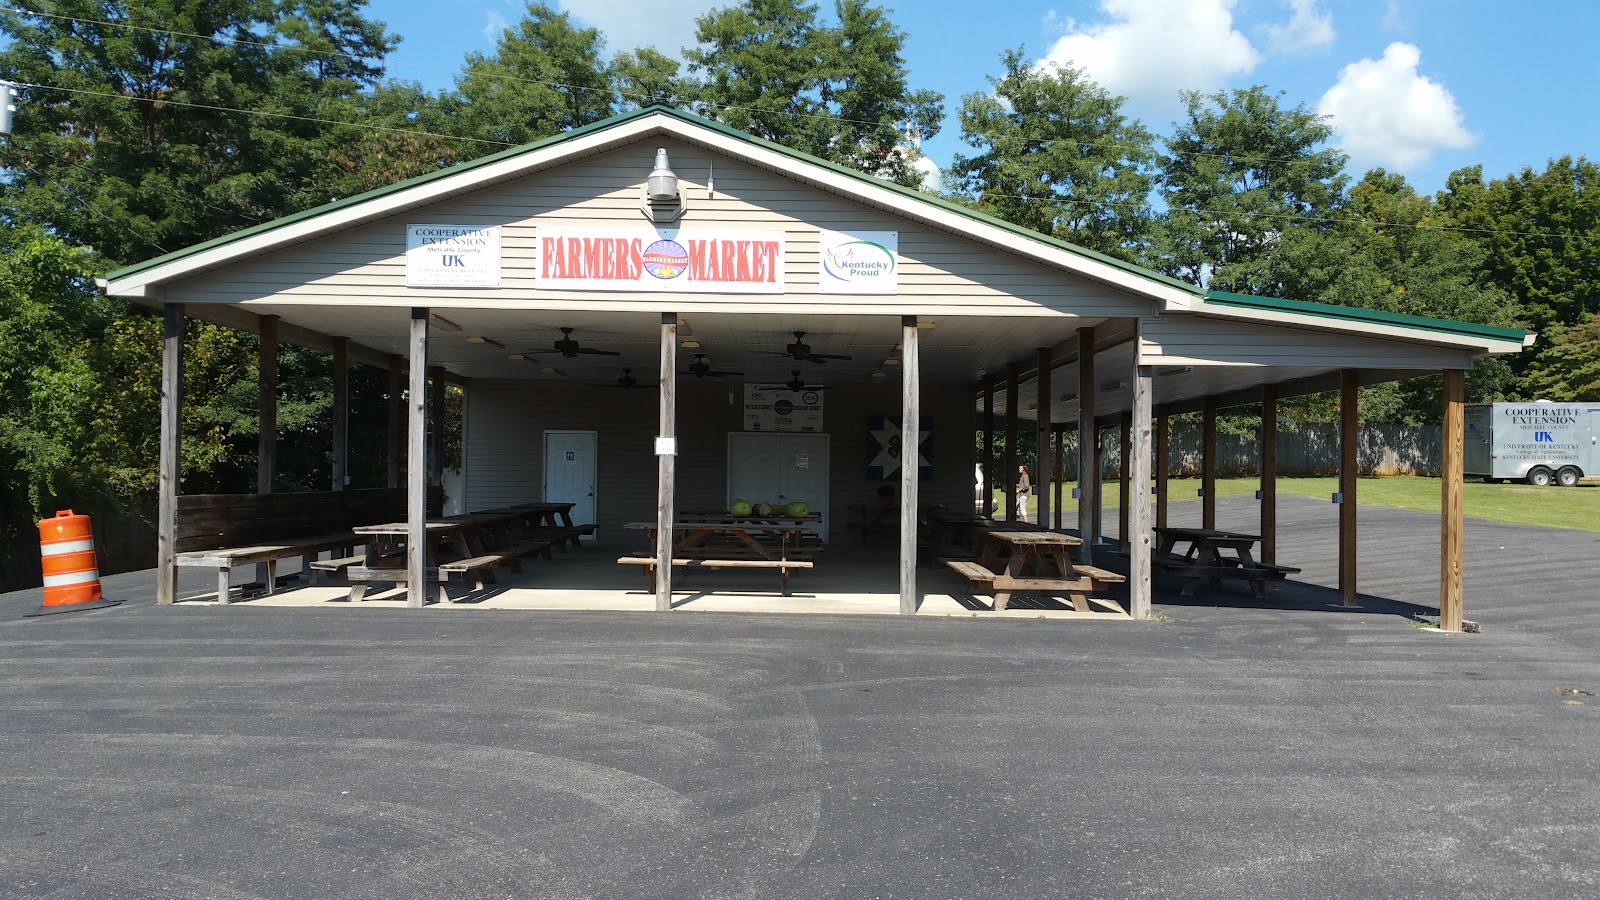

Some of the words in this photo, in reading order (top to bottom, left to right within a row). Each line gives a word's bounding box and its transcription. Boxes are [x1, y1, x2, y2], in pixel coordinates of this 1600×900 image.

[415, 228, 492, 237] COOPERATIVE
[422, 237, 486, 245] EXTENSION
[442, 254, 465, 267] UK
[541, 235, 643, 281] FARMERS
[687, 238, 779, 283] MARKET
[842, 261, 889, 270] Kentucky
[1505, 408, 1581, 416] COOPERATIVE
[1512, 416, 1576, 424] EXTENSION
[1534, 431, 1554, 442] UK
